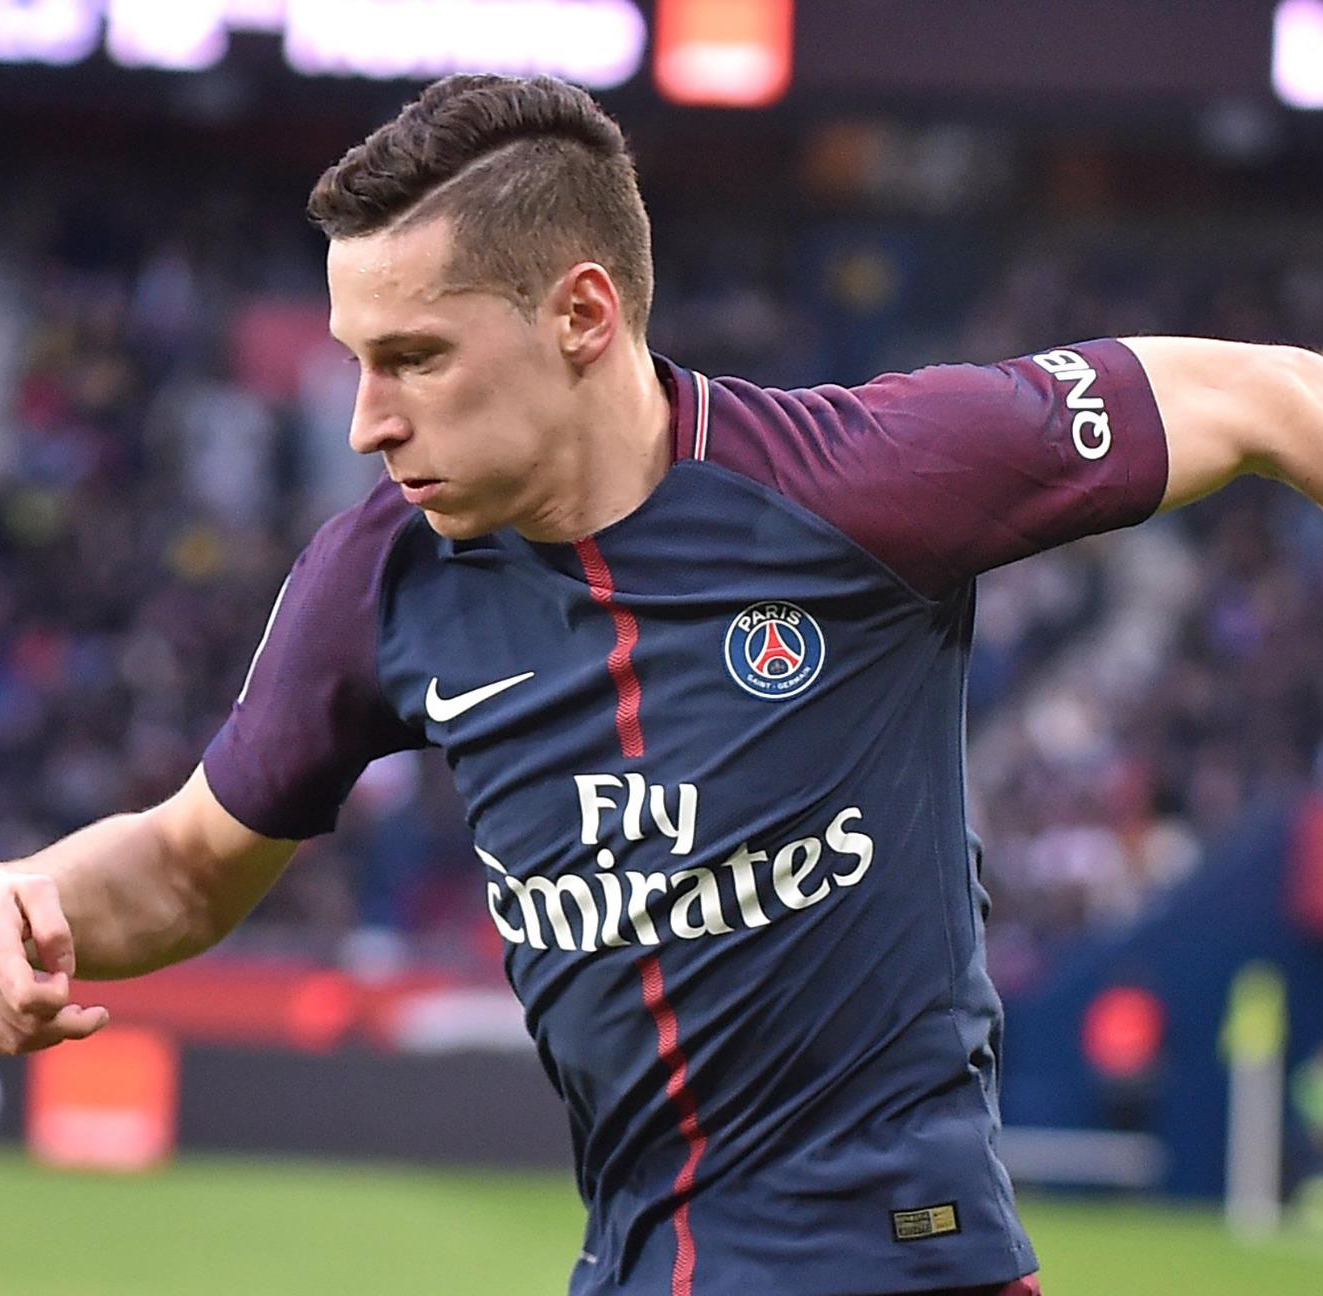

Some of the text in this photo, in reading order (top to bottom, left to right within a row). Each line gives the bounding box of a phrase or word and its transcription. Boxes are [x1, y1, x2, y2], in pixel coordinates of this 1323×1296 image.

[1032, 349, 1111, 460] QNB
[737, 605, 802, 632] PARIS
[573, 772, 698, 854] Fly
